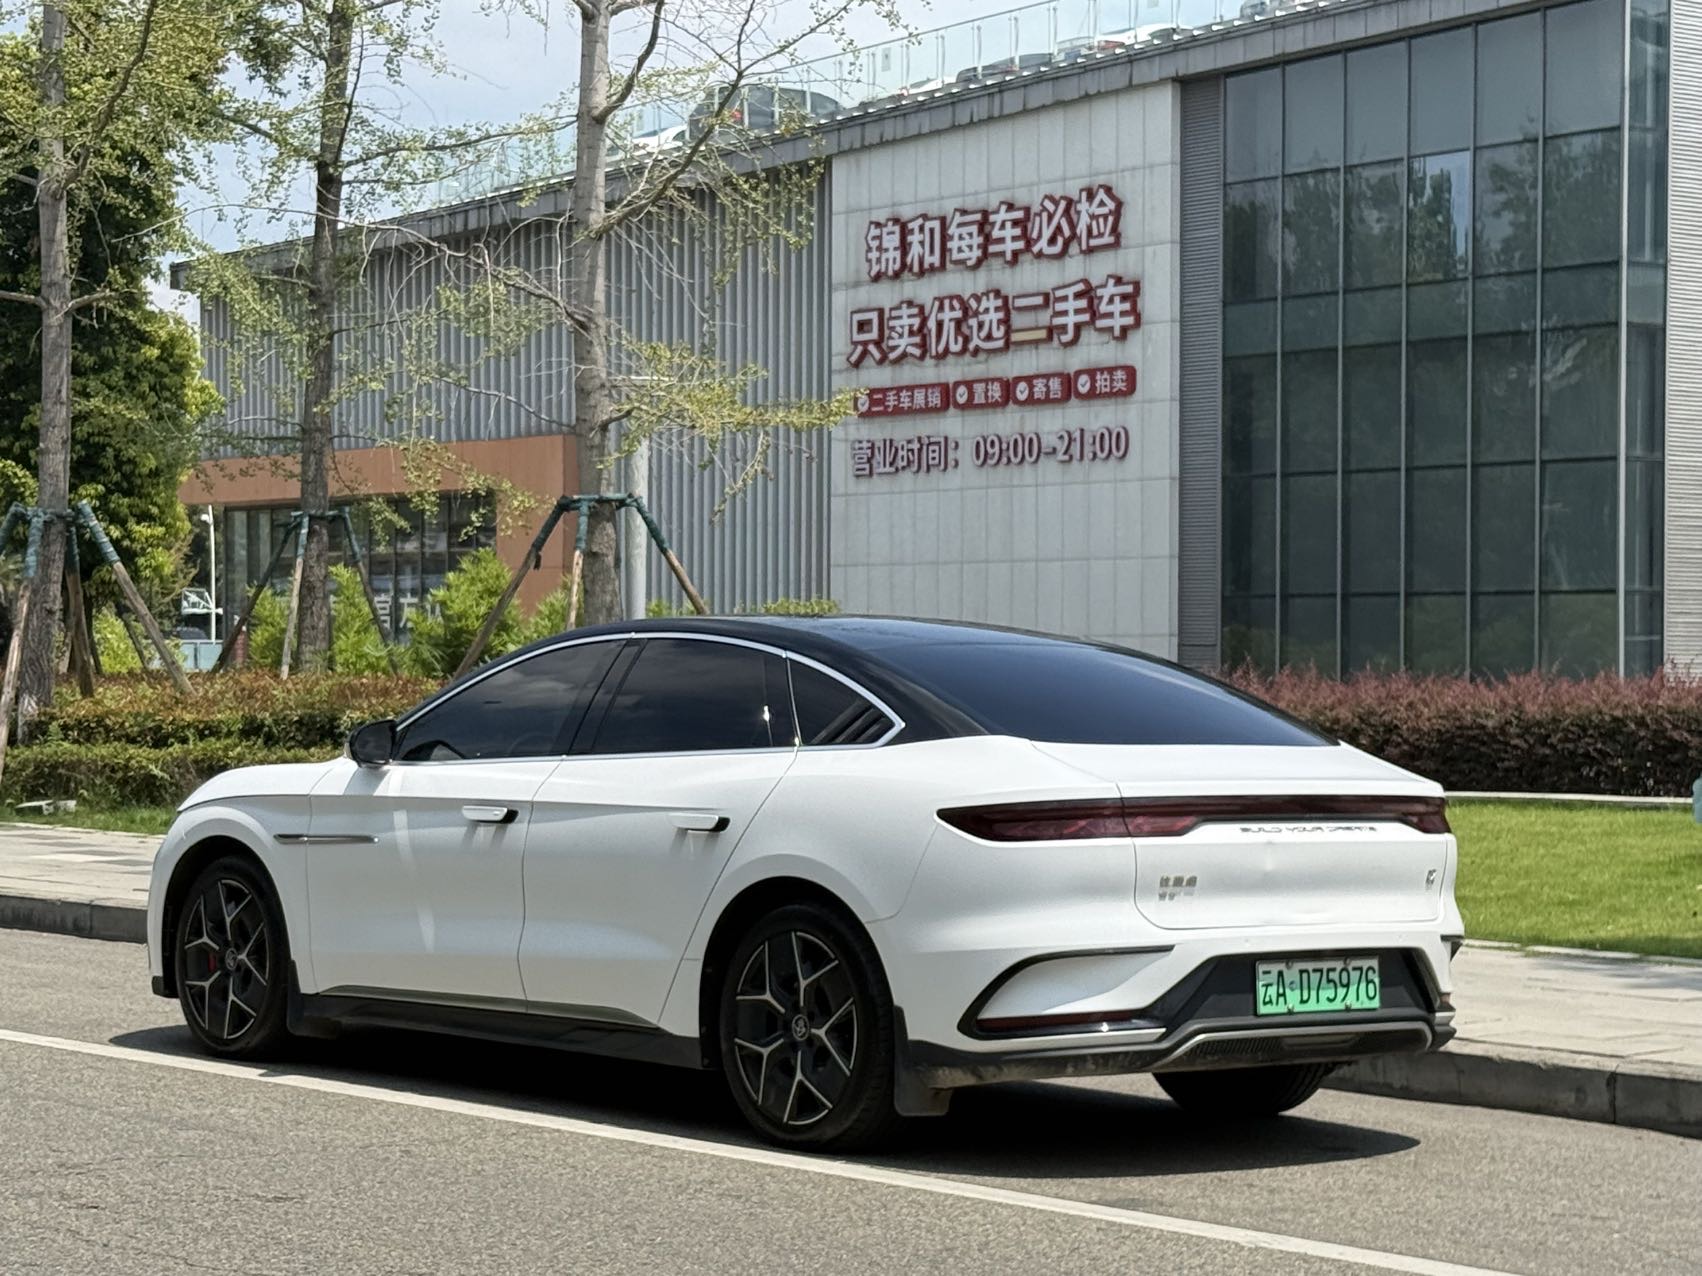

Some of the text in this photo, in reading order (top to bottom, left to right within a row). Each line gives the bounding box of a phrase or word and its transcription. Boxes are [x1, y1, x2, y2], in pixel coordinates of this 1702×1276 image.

[865, 184, 1122, 283] 锦和每车必检
[847, 275, 1141, 368] 只卖优选二手车
[972, 382, 1002, 405] 置换
[1032, 377, 1063, 401] 寄售
[1095, 370, 1128, 394] 拍卖
[869, 389, 942, 413] 二手车展销
[852, 426, 1130, 478] 营业时间： 09:00-21:00
